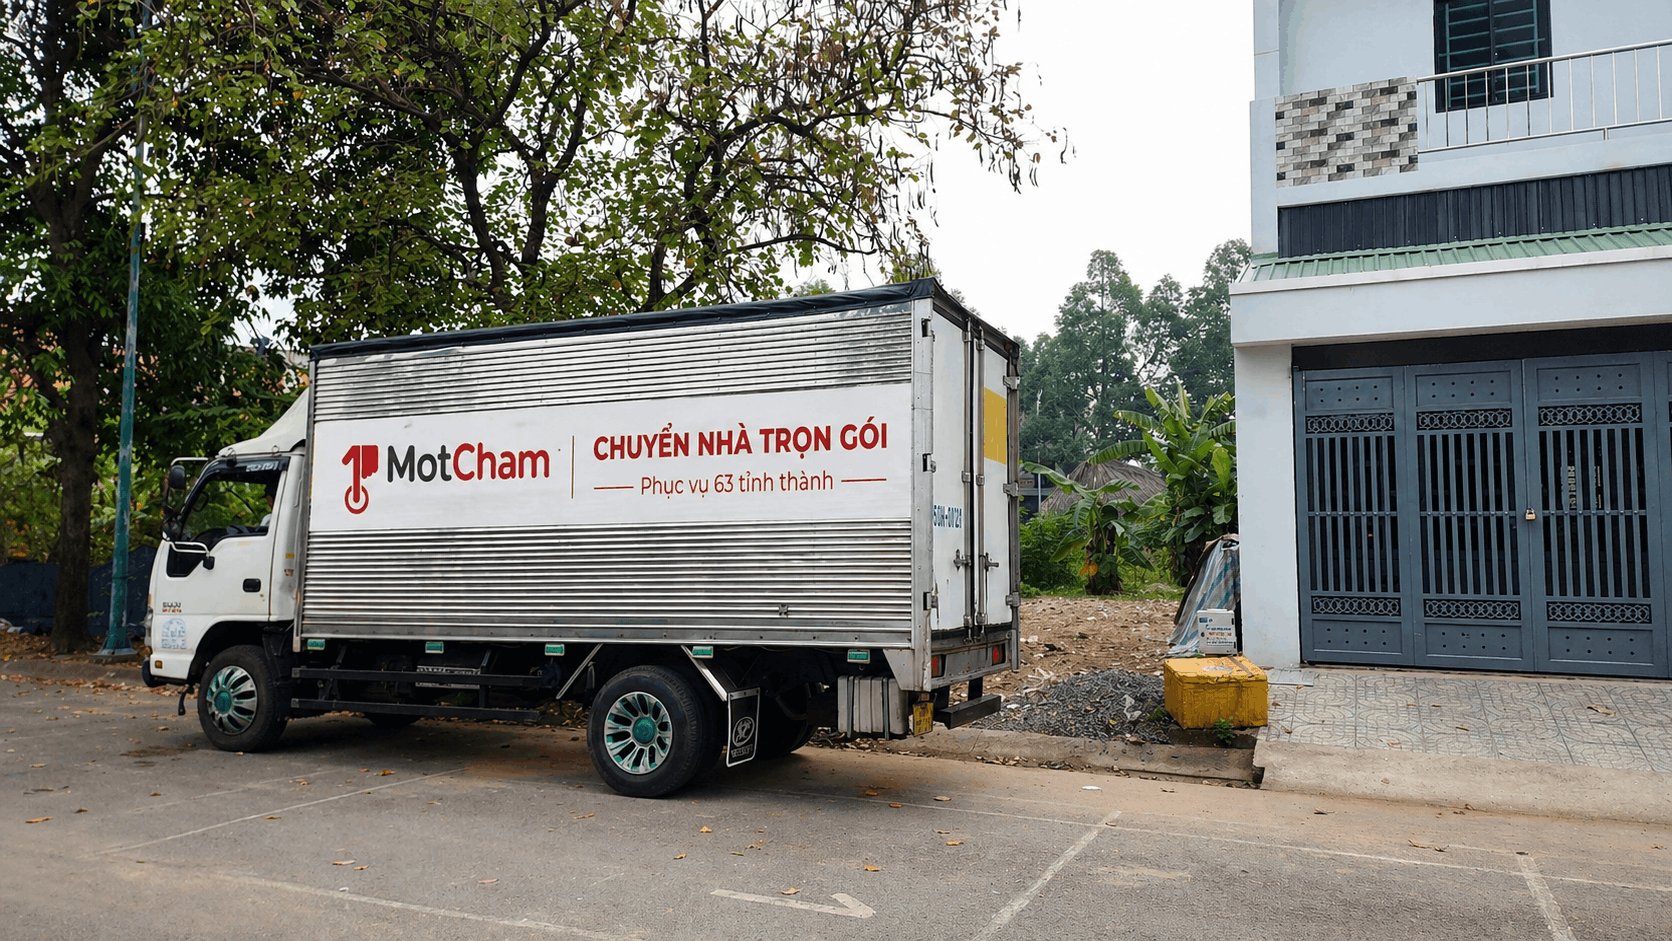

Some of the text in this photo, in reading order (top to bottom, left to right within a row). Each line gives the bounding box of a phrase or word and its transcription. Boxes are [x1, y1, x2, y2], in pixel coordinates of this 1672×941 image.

[593, 416, 887, 461] CHUYỂN NHÀ TRỌN GÓI
[387, 442, 550, 482] MotCham
[641, 469, 833, 499] Phục vụ 63 tỉnh thành
